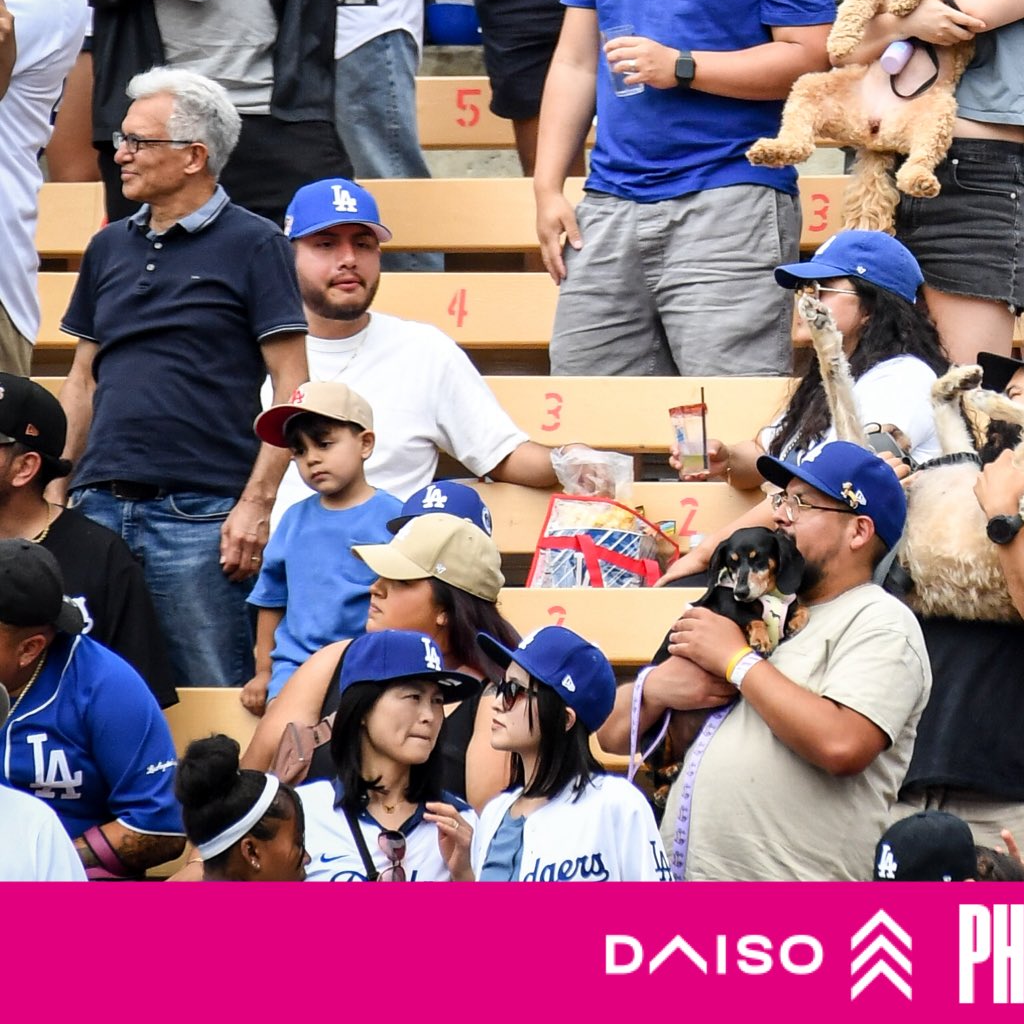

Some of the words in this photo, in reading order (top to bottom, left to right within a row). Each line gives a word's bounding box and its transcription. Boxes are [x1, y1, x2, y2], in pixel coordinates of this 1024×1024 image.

[456, 89, 482, 127] 5
[331, 184, 358, 213] LA
[808, 193, 830, 232] 3
[447, 288, 468, 327] 4
[541, 392, 563, 432] 3
[422, 484, 449, 509] LA
[679, 497, 699, 537] 2
[421, 637, 442, 672] LA
[27, 732, 84, 799] LA
[650, 840, 674, 881] LA
[877, 843, 898, 880] LA
